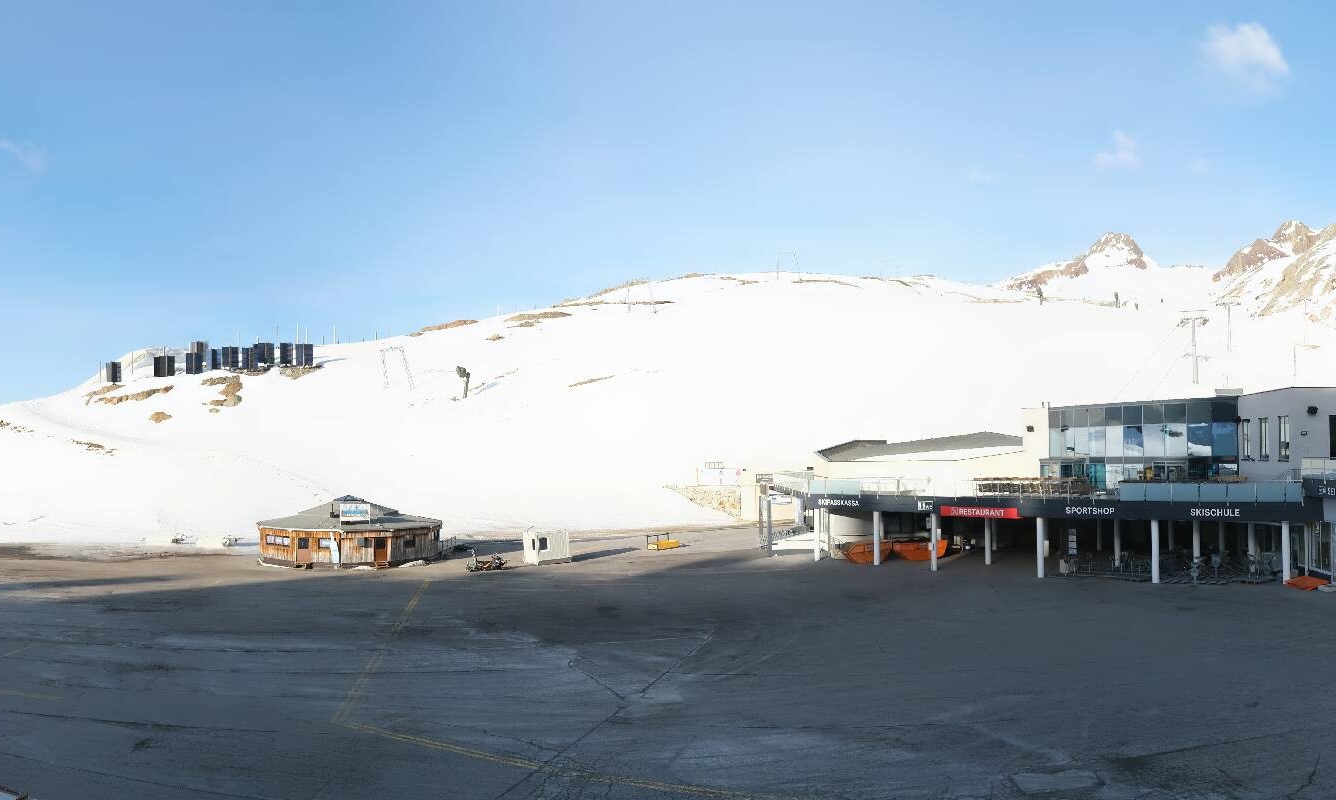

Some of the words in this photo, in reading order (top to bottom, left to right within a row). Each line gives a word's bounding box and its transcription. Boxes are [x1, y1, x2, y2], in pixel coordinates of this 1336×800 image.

[958, 508, 1005, 517] RESTAURANT
[1065, 506, 1115, 515] SPORTSHOP
[1190, 508, 1241, 517] SKISCHULE
